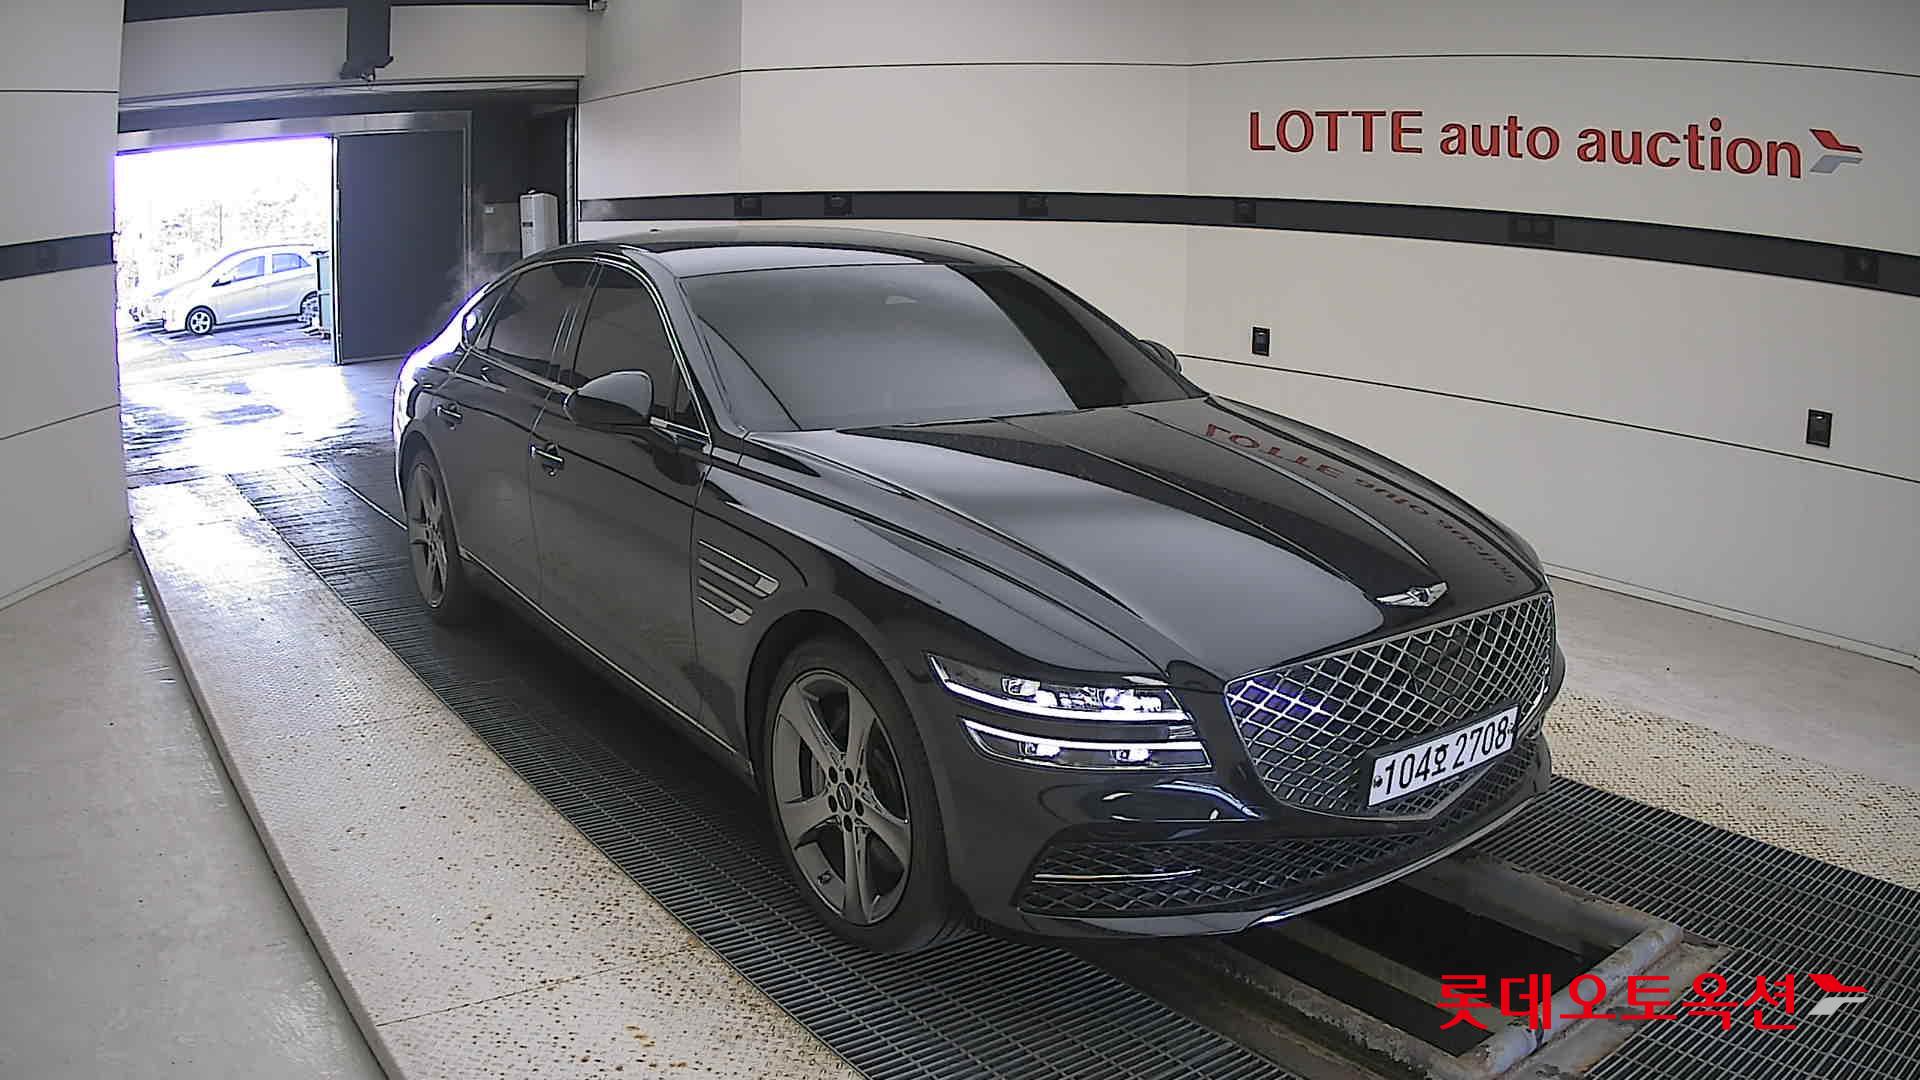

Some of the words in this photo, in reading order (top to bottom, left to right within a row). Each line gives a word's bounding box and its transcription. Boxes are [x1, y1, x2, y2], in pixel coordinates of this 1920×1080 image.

[1249, 110, 1423, 154] LOTTE
[1439, 115, 1560, 160] auto
[1577, 117, 1802, 178] auction
[1385, 743, 1449, 794] 104호
[1452, 716, 1509, 770] 2708
